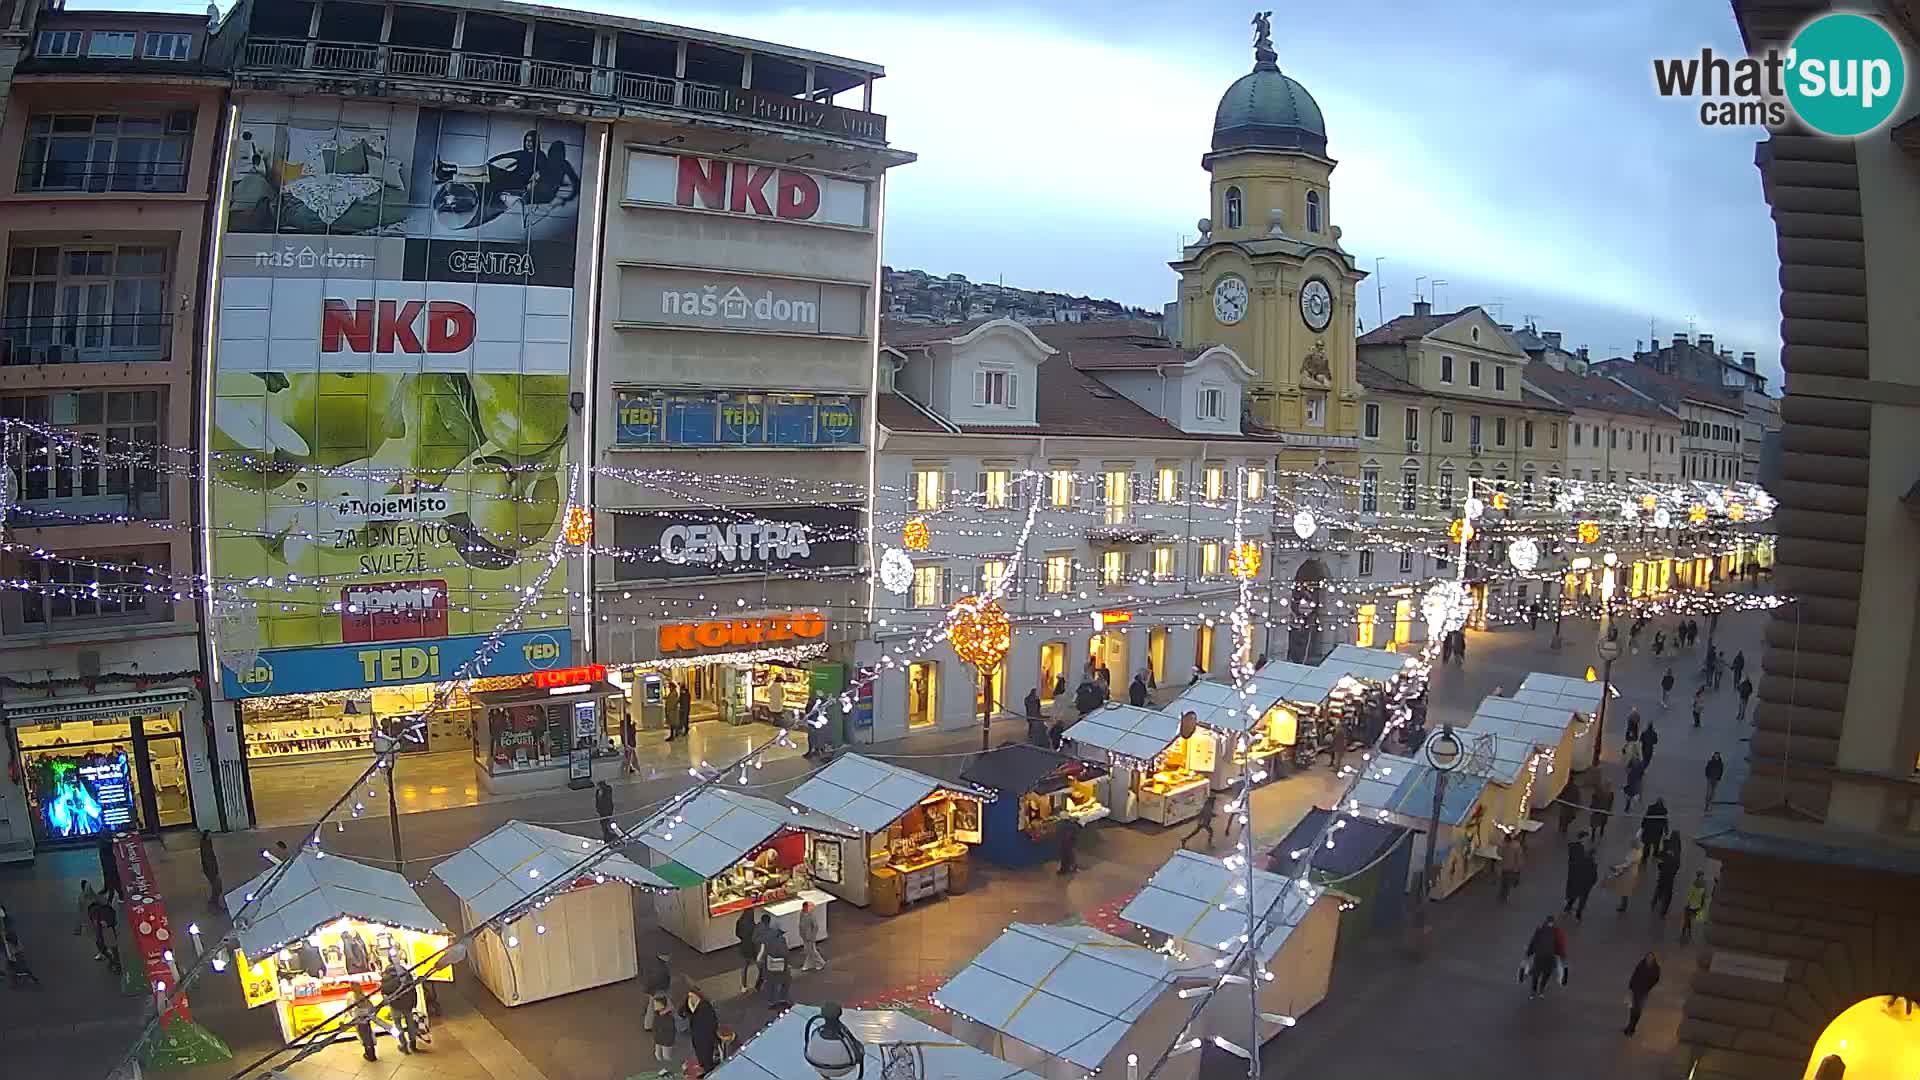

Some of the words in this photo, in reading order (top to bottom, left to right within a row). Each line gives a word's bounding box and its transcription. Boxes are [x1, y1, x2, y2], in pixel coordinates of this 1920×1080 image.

[676, 154, 822, 221] NKD
[255, 243, 294, 268] naš
[319, 247, 366, 269] dom
[448, 249, 536, 277] CENTRA
[661, 283, 718, 317] naš
[754, 289, 817, 323] dom
[320, 297, 477, 354] NKD
[338, 497, 447, 516] #TvojeMisto
[334, 528, 358, 549] ZA
[367, 524, 451, 549] DNEVNO
[659, 521, 811, 565] CENTRA
[358, 646, 441, 683] TEDi
